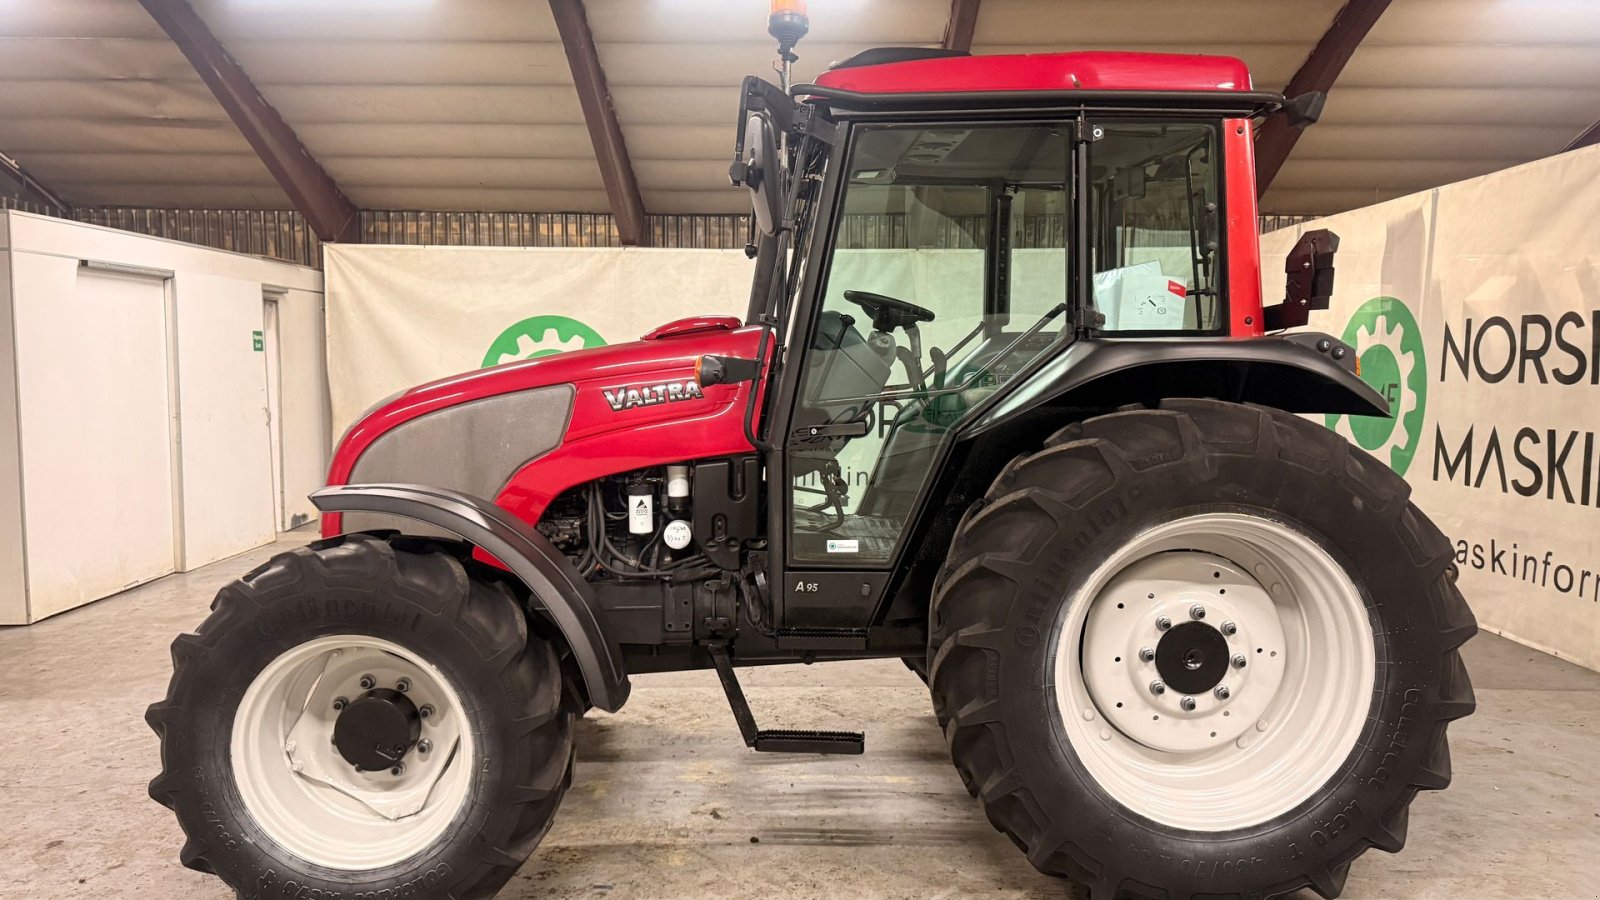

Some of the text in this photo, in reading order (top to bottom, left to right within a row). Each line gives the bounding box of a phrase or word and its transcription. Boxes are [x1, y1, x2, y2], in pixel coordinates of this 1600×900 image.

[1440, 310, 1600, 385] NORS
[603, 380, 704, 411] VALTRA
[1433, 421, 1600, 508] MASKI
[806, 583, 819, 592] 95
[1456, 539, 1600, 602] askinfor
